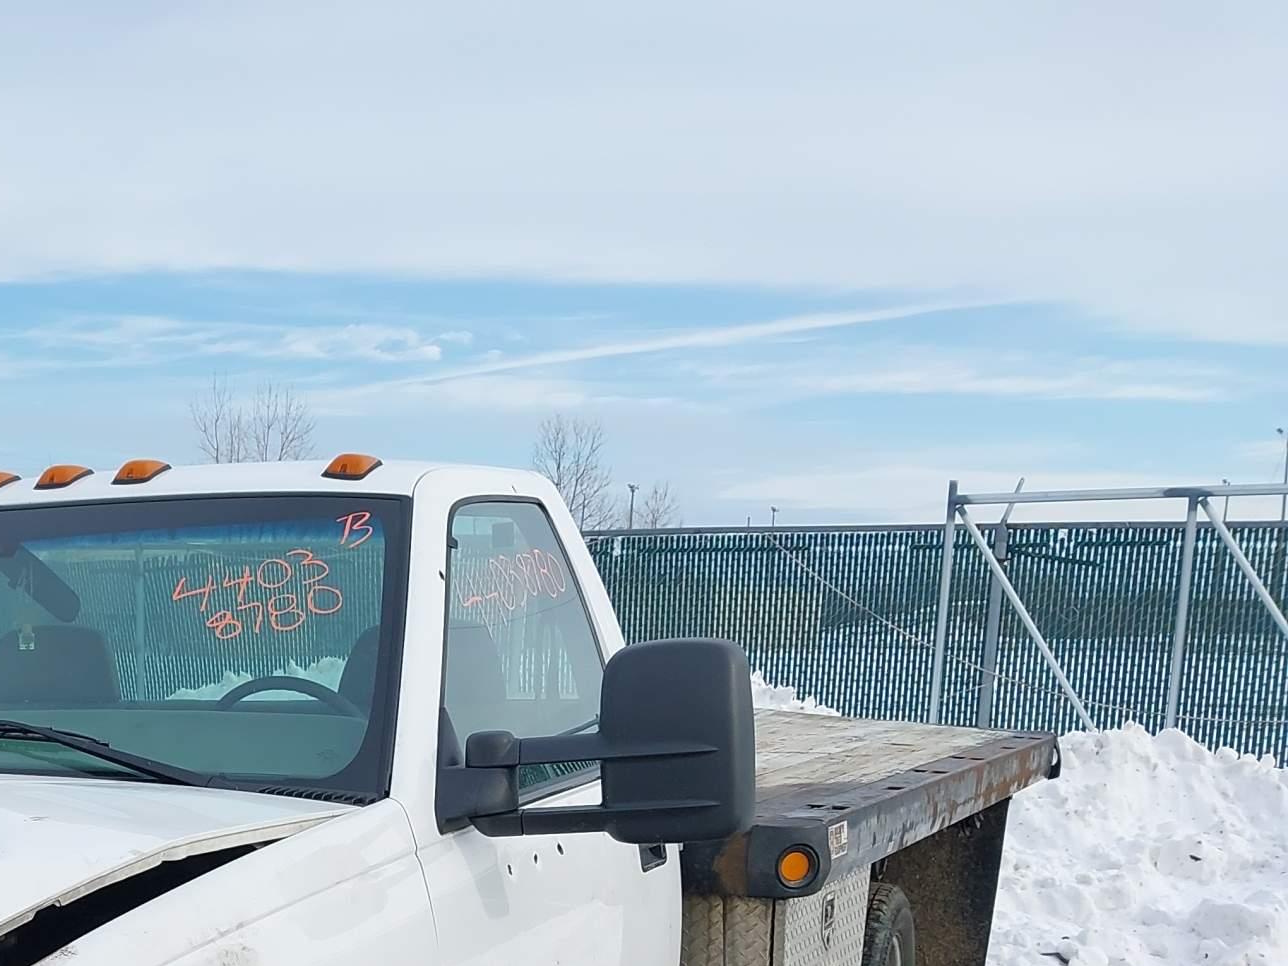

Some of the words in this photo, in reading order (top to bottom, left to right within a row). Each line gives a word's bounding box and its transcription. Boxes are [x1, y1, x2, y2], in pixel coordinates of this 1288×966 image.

[336, 511, 373, 548] B
[172, 549, 329, 612] 4403
[206, 584, 343, 640] 8780
